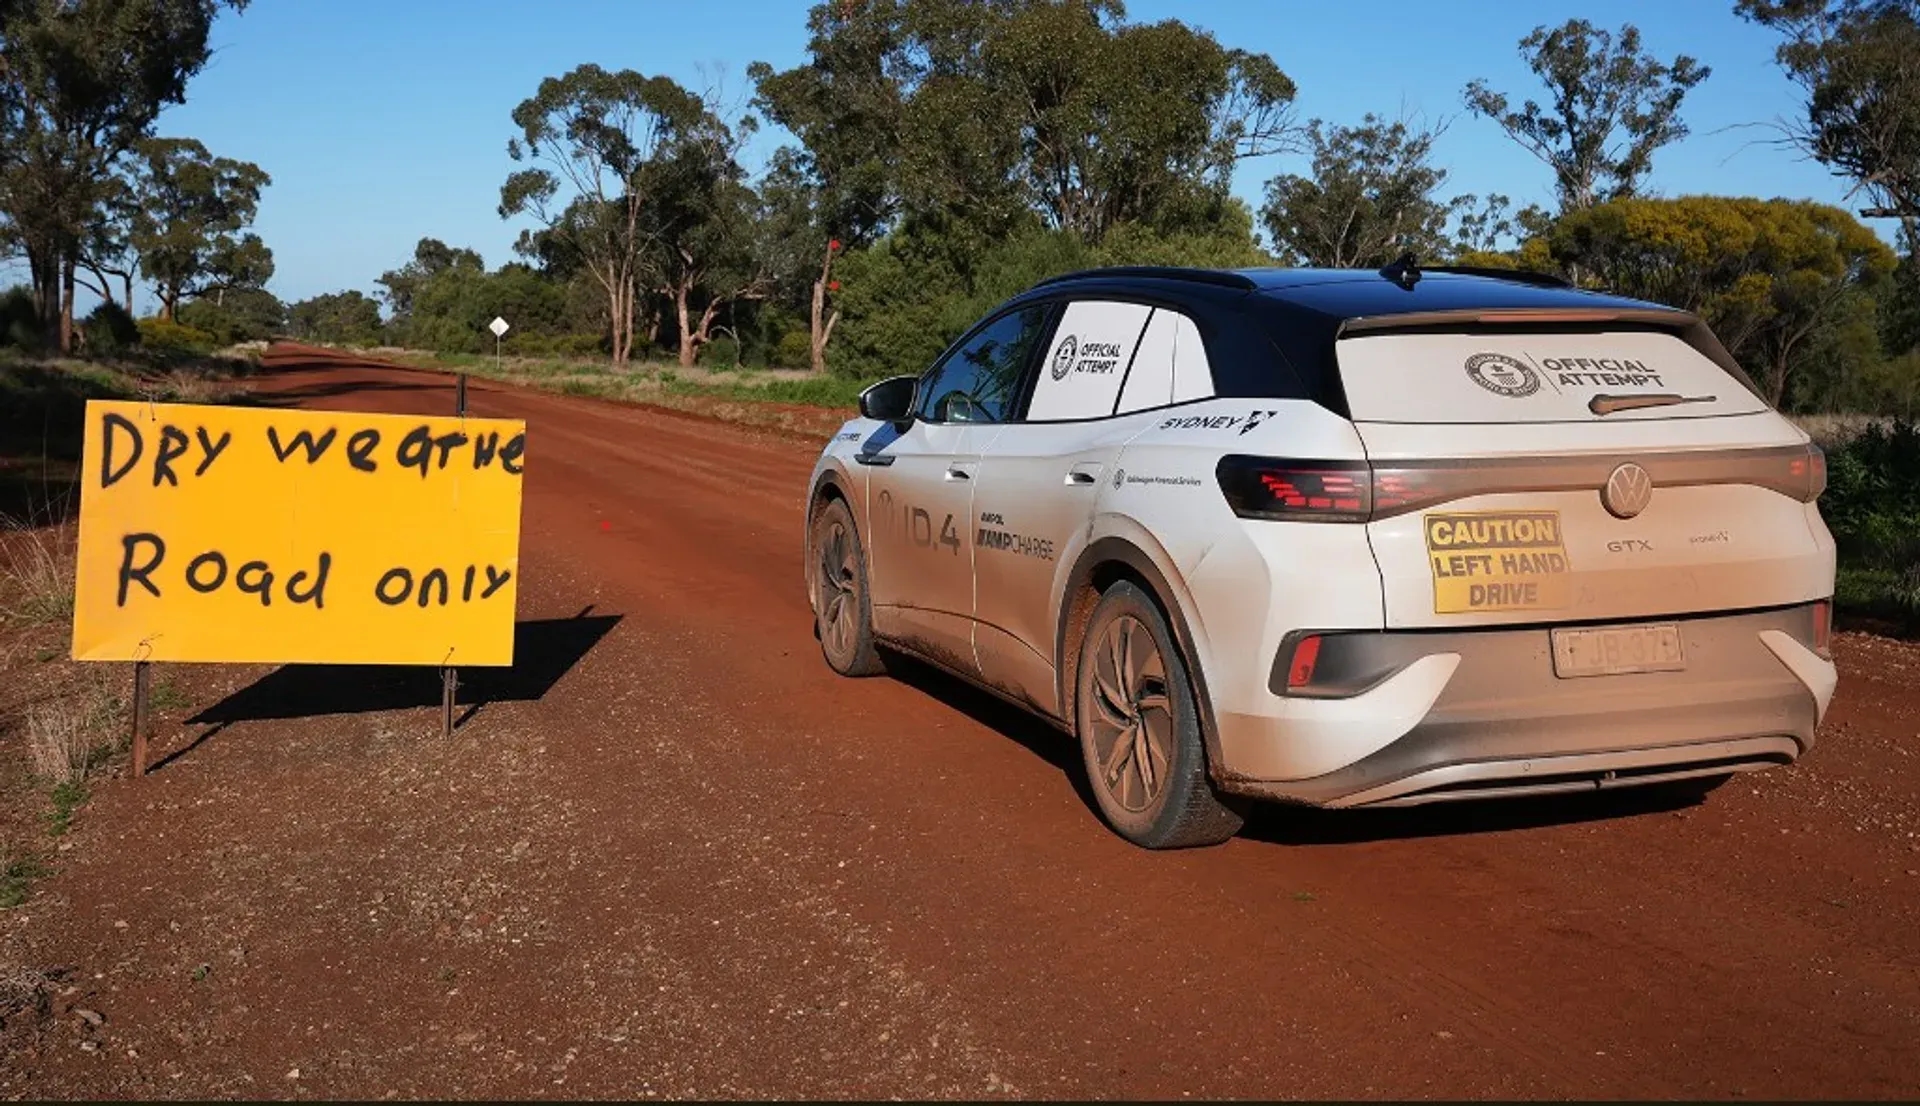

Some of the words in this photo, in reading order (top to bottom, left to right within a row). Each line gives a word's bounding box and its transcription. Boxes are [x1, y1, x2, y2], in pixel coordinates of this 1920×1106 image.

[1081, 343, 1120, 357] OFFICIAL
[1075, 360, 1117, 373] ATTEMPT
[1543, 357, 1656, 373] OFFICIAL
[1558, 372, 1665, 388] ATTEMPT
[1160, 416, 1243, 430] SYDNEY
[904, 504, 960, 556] ID.4
[1431, 519, 1555, 545] CAUTION
[1606, 540, 1653, 552] GTX
[117, 532, 331, 609] Road
[375, 564, 511, 608] only
[1434, 555, 1492, 578] LEFT
[1500, 553, 1565, 575] HAND
[1470, 583, 1537, 606] DRIVE
